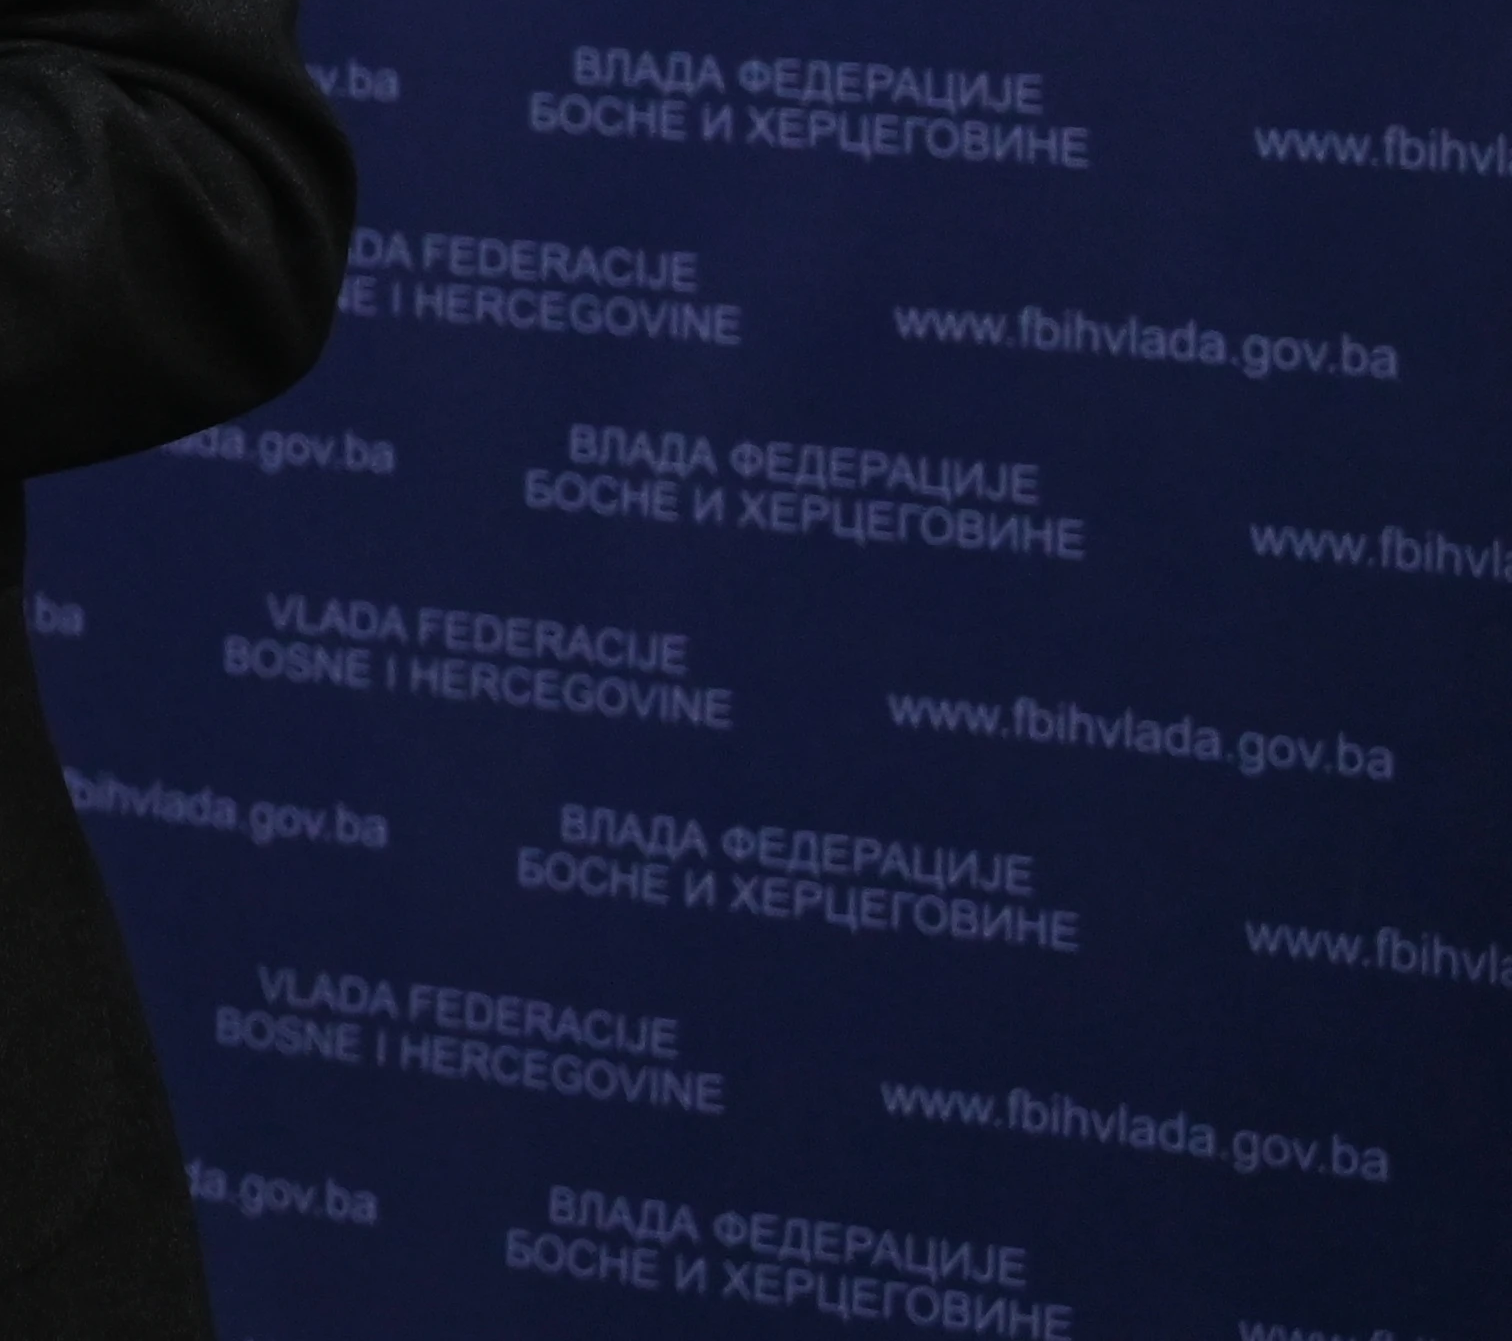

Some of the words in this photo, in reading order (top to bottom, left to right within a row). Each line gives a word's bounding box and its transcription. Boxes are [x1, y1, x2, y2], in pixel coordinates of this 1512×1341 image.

[572, 45, 726, 97] ВЛАДА
[736, 57, 1043, 115] ФЕДЕРАЦИЈЕ
[528, 90, 686, 142] БОСНЕ
[697, 102, 737, 144] И
[746, 107, 1089, 169] ХЕРЦЕГОВИНЕ
[421, 234, 697, 293] FEDERACIJE
[388, 281, 405, 316] I
[413, 284, 741, 346] HERCEGOVINE
[893, 305, 1400, 380] www.fbihvlada.gov.ba
[568, 423, 718, 478] ВЛАДА
[728, 440, 1039, 501] ФЕДЕРАЦИЈЕ
[523, 468, 678, 523] БОСНЕ
[689, 485, 729, 526] И
[738, 490, 1085, 561] ХЕРЦЕГОВИНЕ
[266, 593, 409, 642] VLADA
[416, 606, 688, 676] FEDERACIJE
[222, 636, 370, 689] BOSNE
[382, 654, 400, 691] I
[409, 658, 732, 730] HERCEGOVINE
[886, 693, 1396, 781] www.fbihvlada.gov.ba
[559, 805, 709, 862] ВЛАДА
[720, 824, 1033, 897] ФЕДЕРАЦИЈЕ
[516, 848, 669, 905] БОСНЕ
[680, 869, 720, 910] И
[729, 875, 1079, 952] ХЕРЦЕГОВИНЕ
[258, 965, 400, 1019] VLADA
[407, 983, 678, 1060] FEDERACIJE
[214, 1005, 360, 1063] BOSNE
[372, 1028, 391, 1067] I
[399, 1034, 725, 1115] HERCEGOVINE
[880, 1082, 1391, 1183] www.fbihvlada.gov.ba
[548, 1185, 701, 1245] ВЛАДА
[711, 1210, 1026, 1289] ФЕДЕРАЦИЈЕ
[505, 1227, 659, 1290] БОСНЕ
[671, 1254, 712, 1295] И
[722, 1261, 1072, 1341] ХЕРЦЕГОВИНЕ
